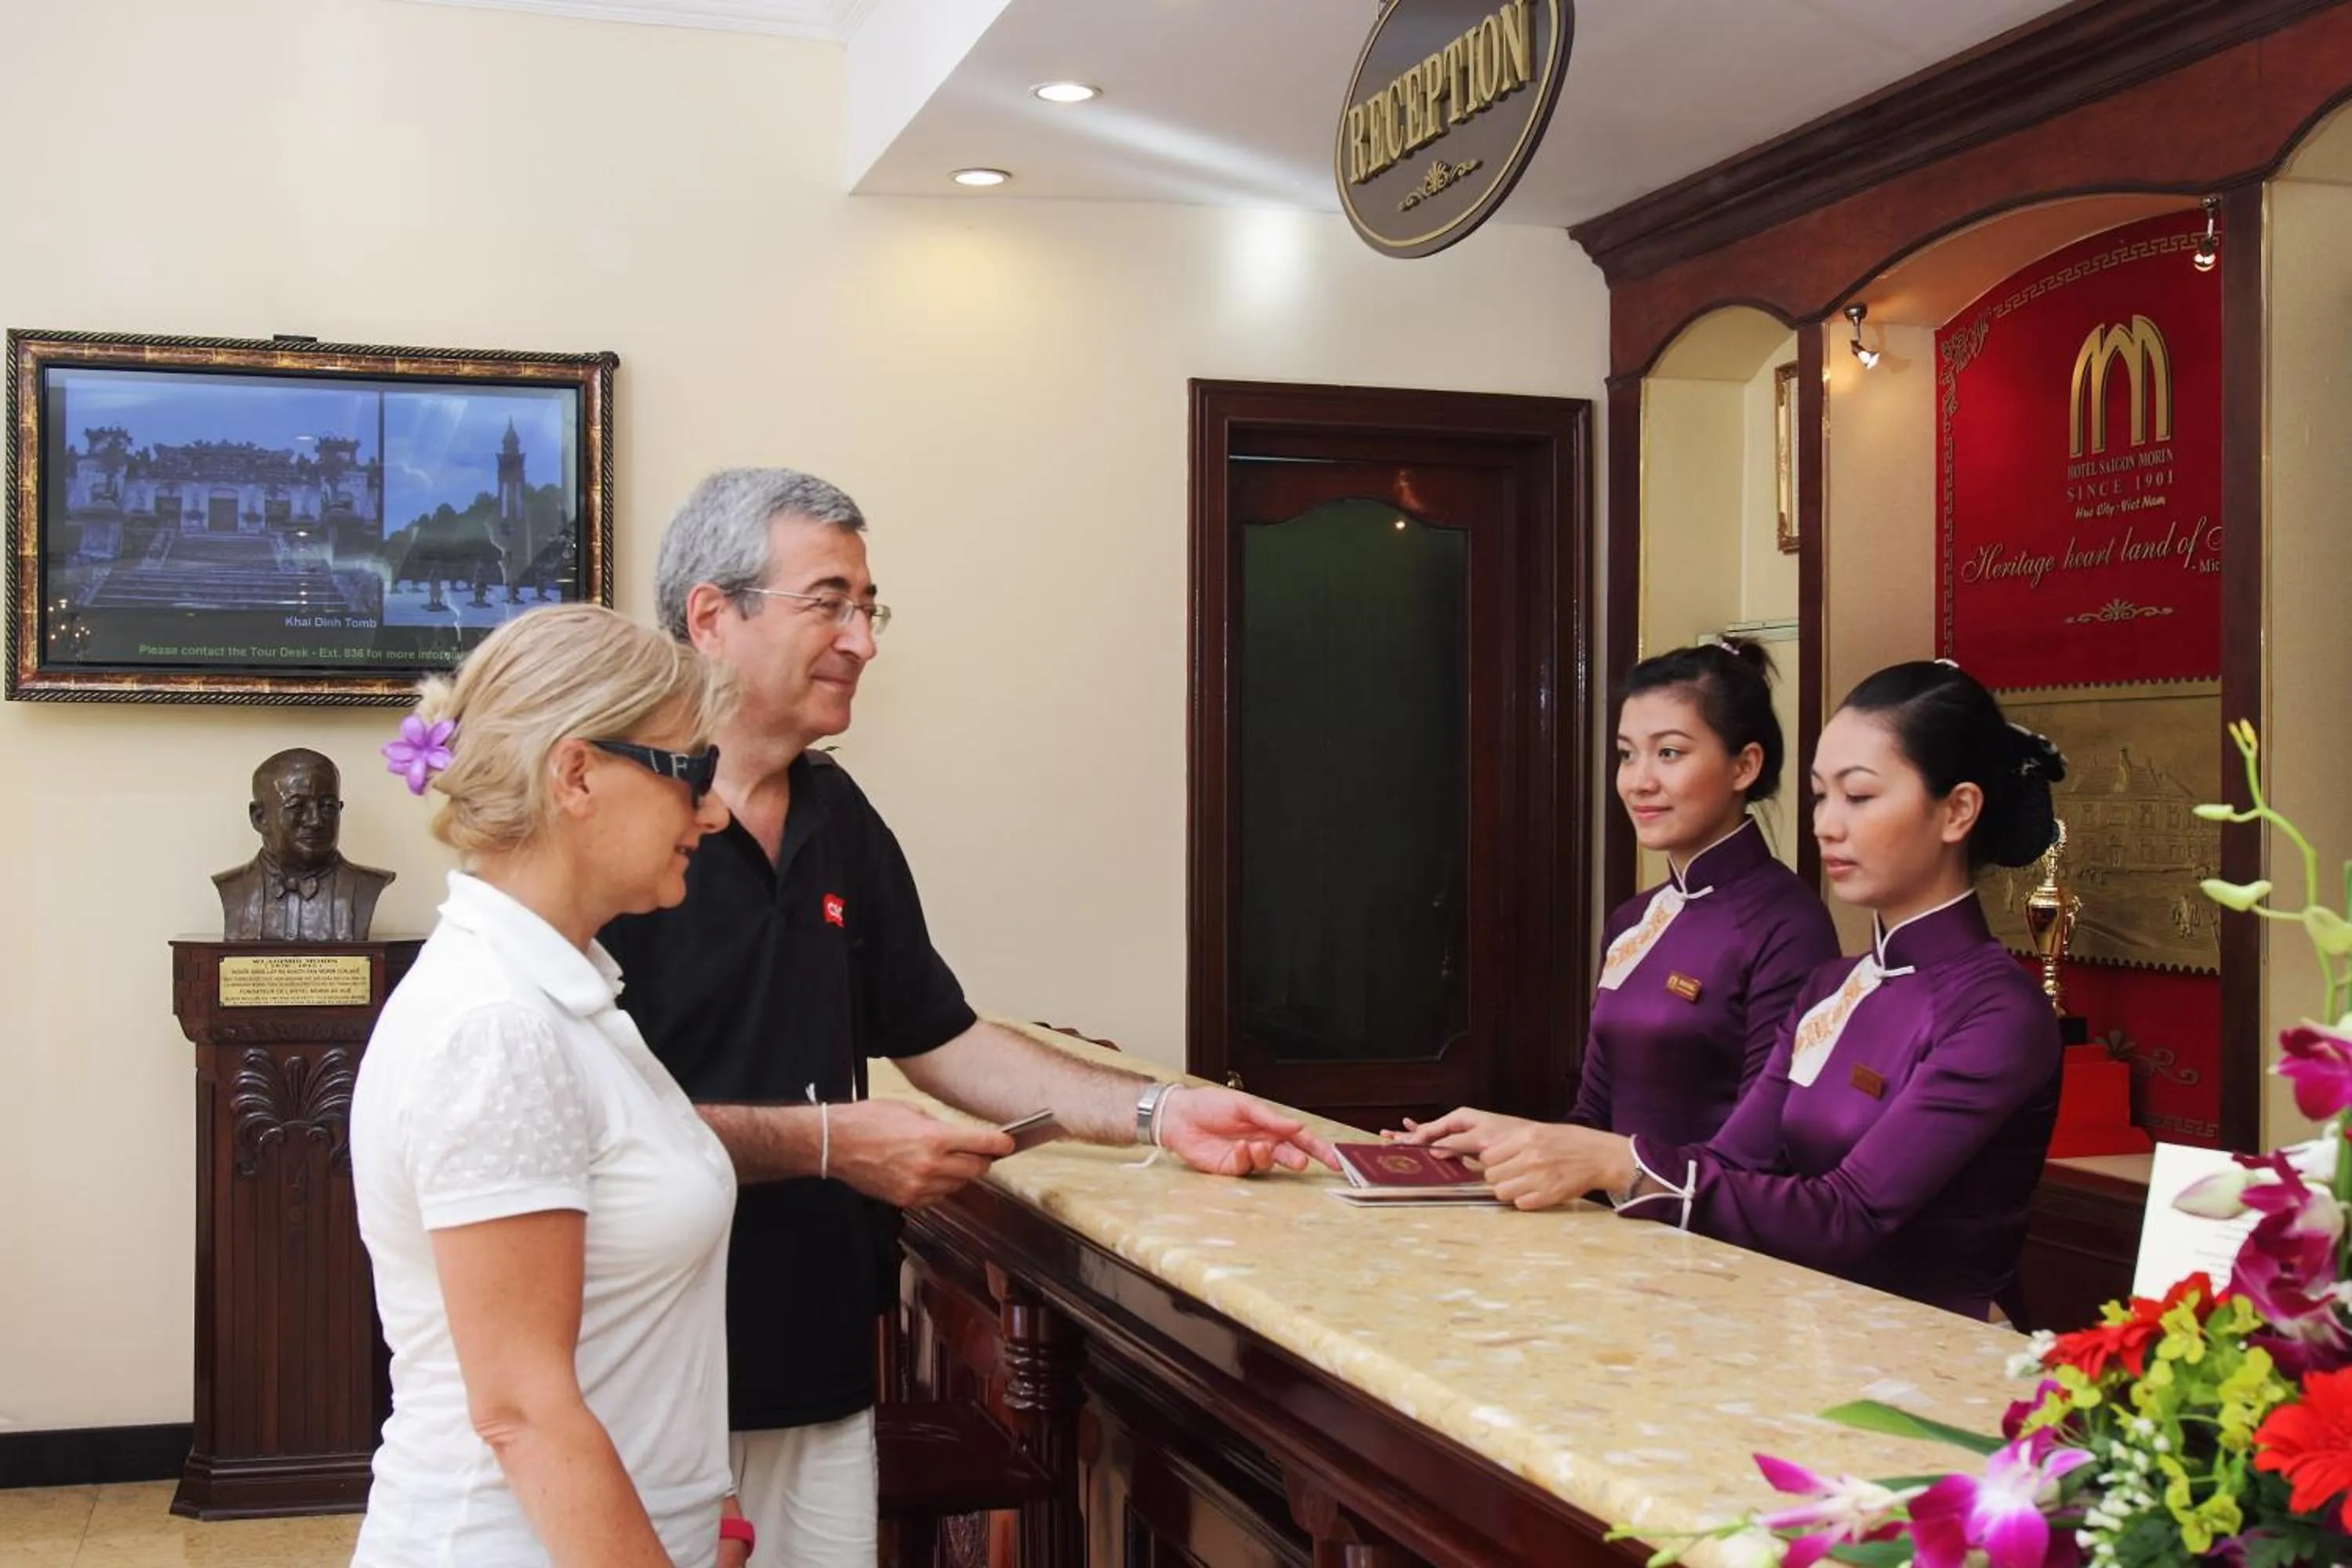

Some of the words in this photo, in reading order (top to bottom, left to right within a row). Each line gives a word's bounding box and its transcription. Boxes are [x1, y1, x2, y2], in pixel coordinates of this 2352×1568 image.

[1347, 0, 1532, 185] RECEPTION
[2067, 460, 2098, 481] HOTEL
[2099, 455, 2135, 474] SAIGON
[2138, 448, 2173, 468] MORIN
[2067, 478, 2122, 503] SINCE
[2136, 470, 2173, 491] 1901
[2096, 501, 2115, 517] City
[1961, 542, 2056, 589] Heritage
[2062, 535, 2116, 571] heart
[2120, 521, 2176, 562] land
[2177, 516, 2207, 569] of
[314, 616, 341, 628] Dinh
[344, 616, 377, 629] Tomb
[139, 644, 178, 655] Please
[180, 646, 224, 657] contact
[227, 646, 248, 657] the
[250, 646, 276, 657] Tour
[279, 646, 309, 658] Desk
[366, 648, 383, 659] for
[386, 650, 415, 659] more
